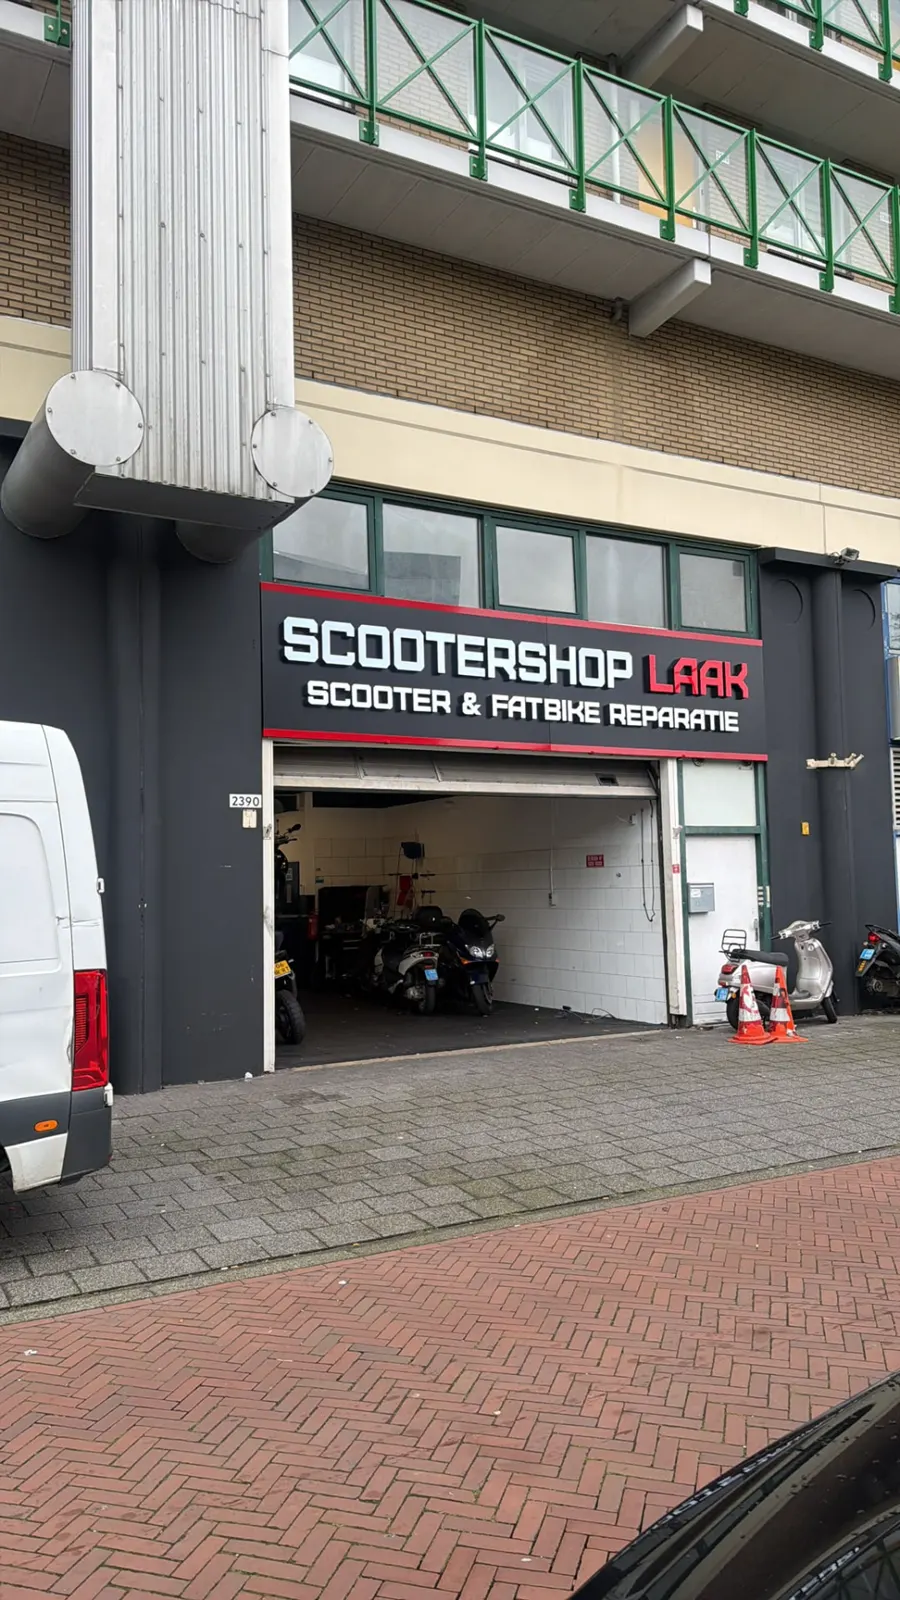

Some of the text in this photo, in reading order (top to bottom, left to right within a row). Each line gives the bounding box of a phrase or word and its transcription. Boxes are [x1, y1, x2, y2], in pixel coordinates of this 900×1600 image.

[283, 616, 749, 699] SCOOTERSHOP LAAK
[307, 680, 739, 732] SCOOTER & FATBIKE REPARATIE
[232, 796, 260, 807] 2390
